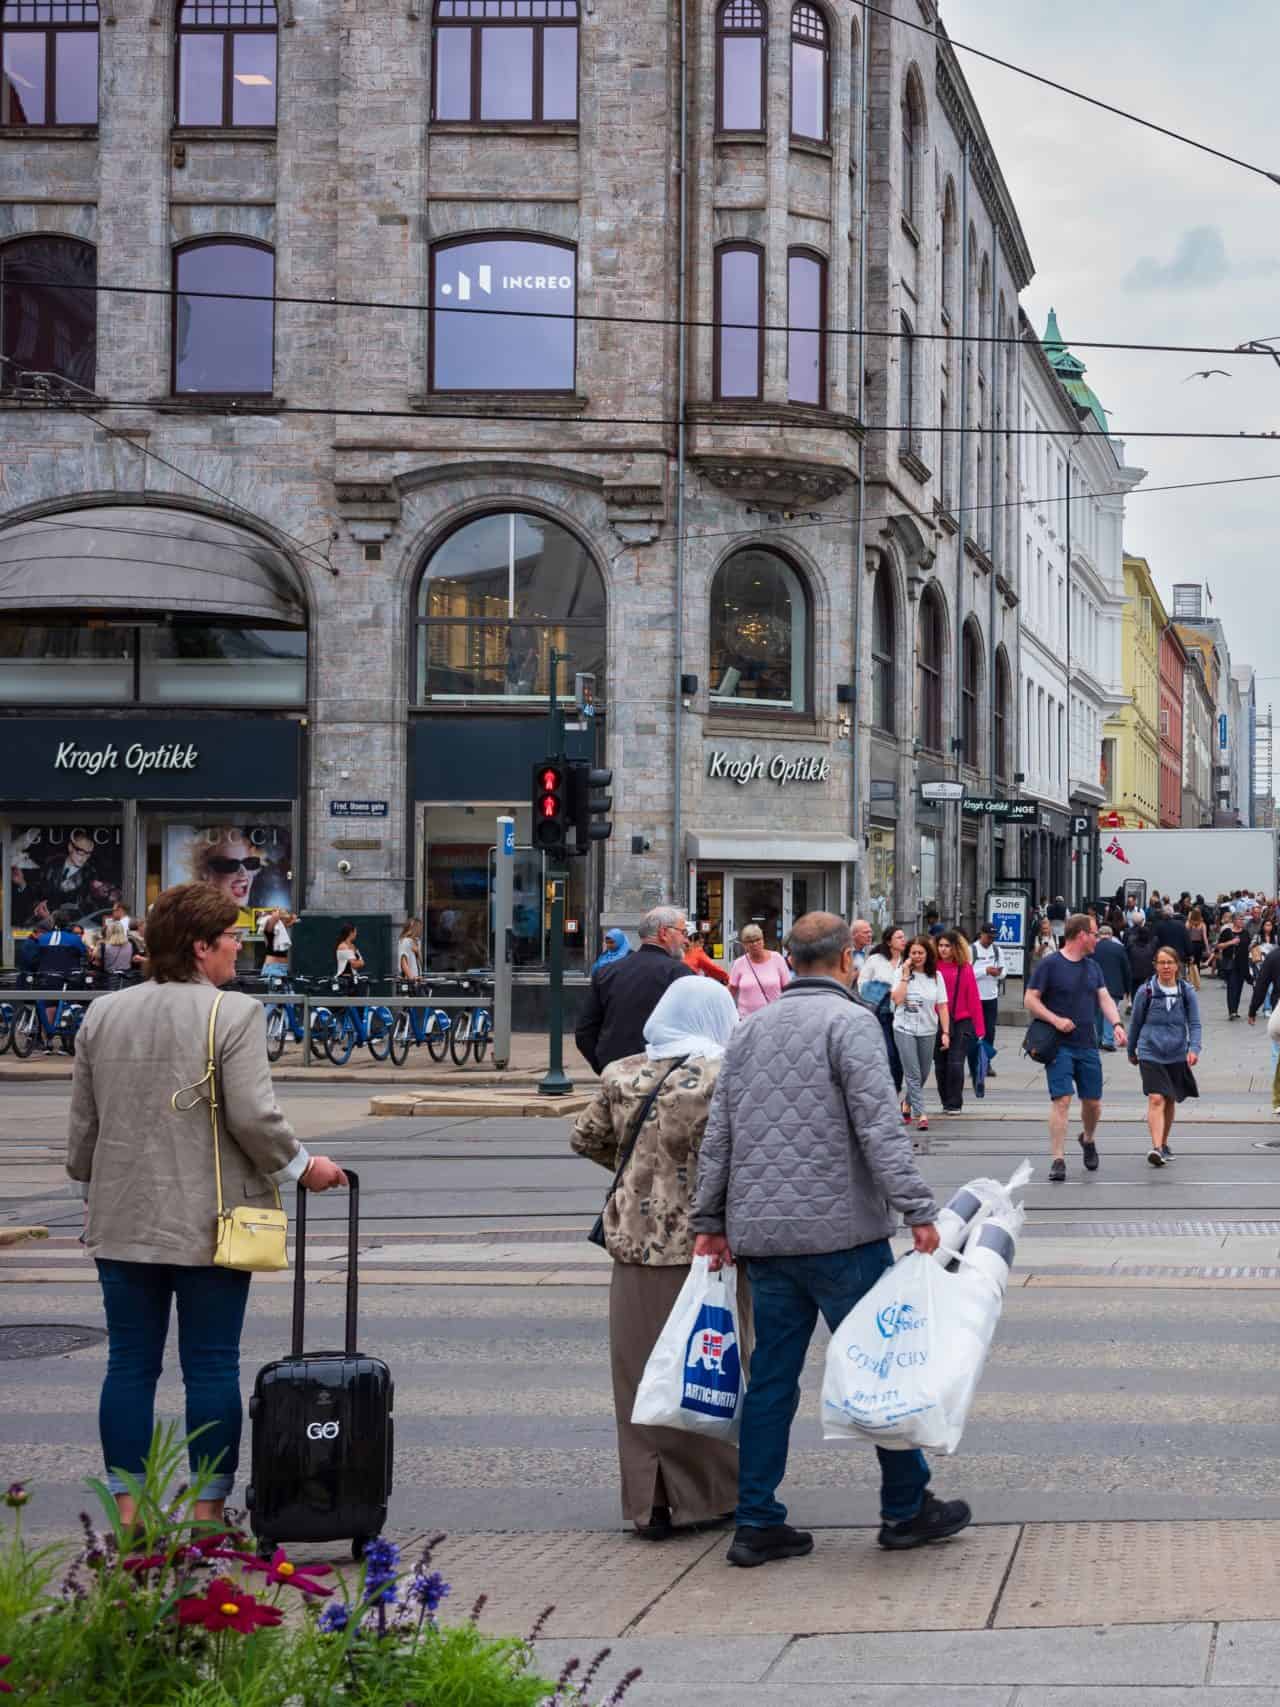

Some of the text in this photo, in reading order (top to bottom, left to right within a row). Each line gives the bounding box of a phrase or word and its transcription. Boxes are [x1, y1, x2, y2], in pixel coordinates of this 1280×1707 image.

[503, 276, 571, 289] INCREO
[54, 742, 198, 775] Krogh Optikk
[710, 752, 831, 785] Krogh Optikk
[26, 827, 120, 845] GUCCI
[995, 900, 1020, 909] Sone
